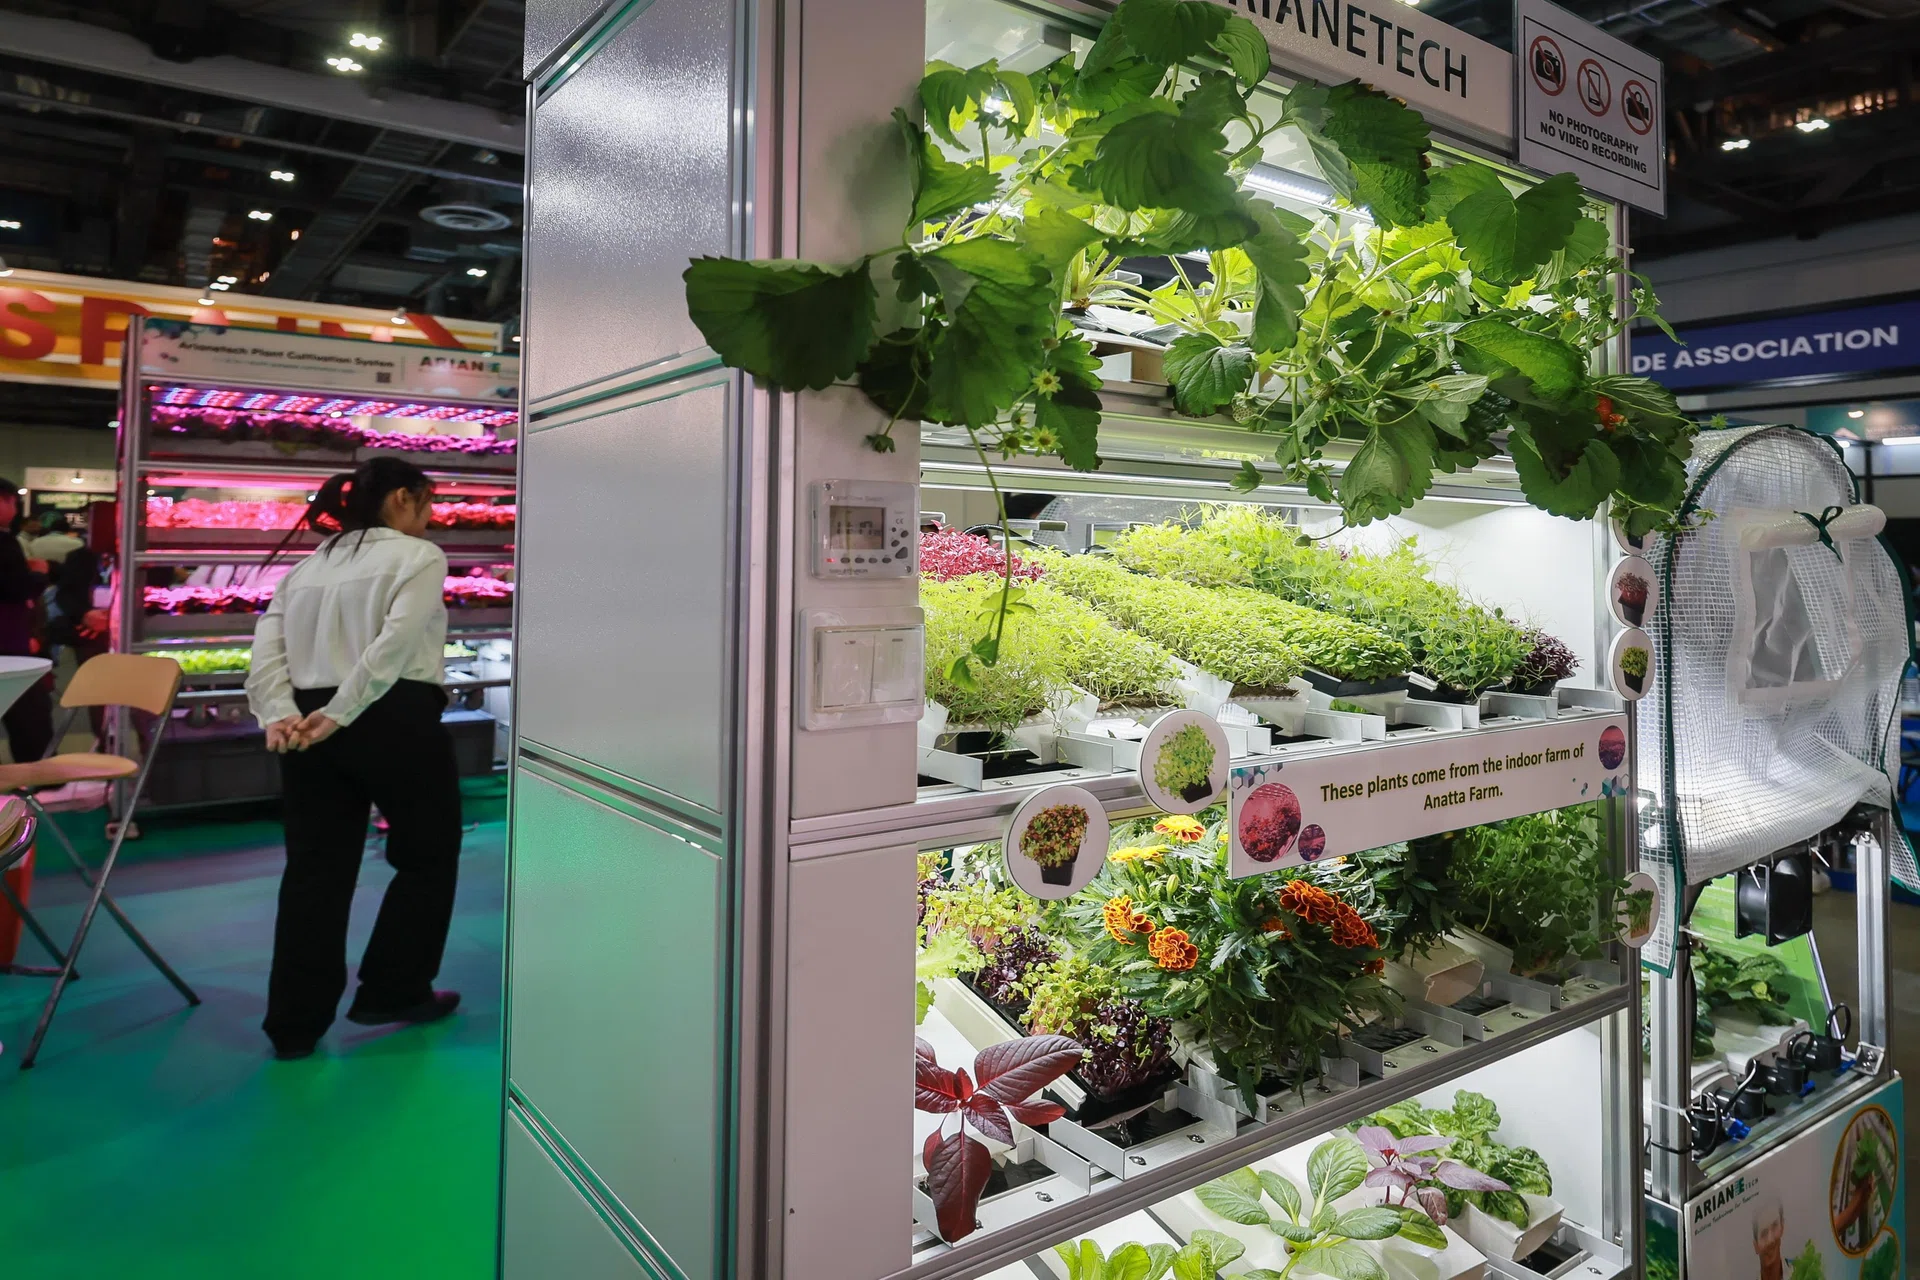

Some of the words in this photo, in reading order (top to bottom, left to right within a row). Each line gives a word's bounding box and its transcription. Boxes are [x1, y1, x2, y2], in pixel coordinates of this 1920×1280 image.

[1229, 0, 1467, 98] ANETECH
[1540, 121, 1556, 137] NO
[1558, 128, 1589, 151] VIDEO
[1591, 142, 1647, 173] RECORDING
[1549, 109, 1564, 125] NO
[1567, 117, 1639, 155] PHOTOGRAPHY
[251, 347, 284, 359] Plant
[287, 351, 351, 364] Cultivation
[355, 356, 395, 368] System
[1673, 325, 1898, 369] ASSOCIATION
[1321, 783, 1363, 802] These
[1367, 773, 1408, 798] plants
[1411, 768, 1446, 786] come
[1449, 763, 1480, 779] from
[1483, 757, 1503, 774] the
[1505, 751, 1543, 770] indoor
[1545, 748, 1571, 764] farm
[1573, 743, 1585, 758] of
[1423, 789, 1466, 811] Anatta
[1469, 784, 1503, 802] Farm.
